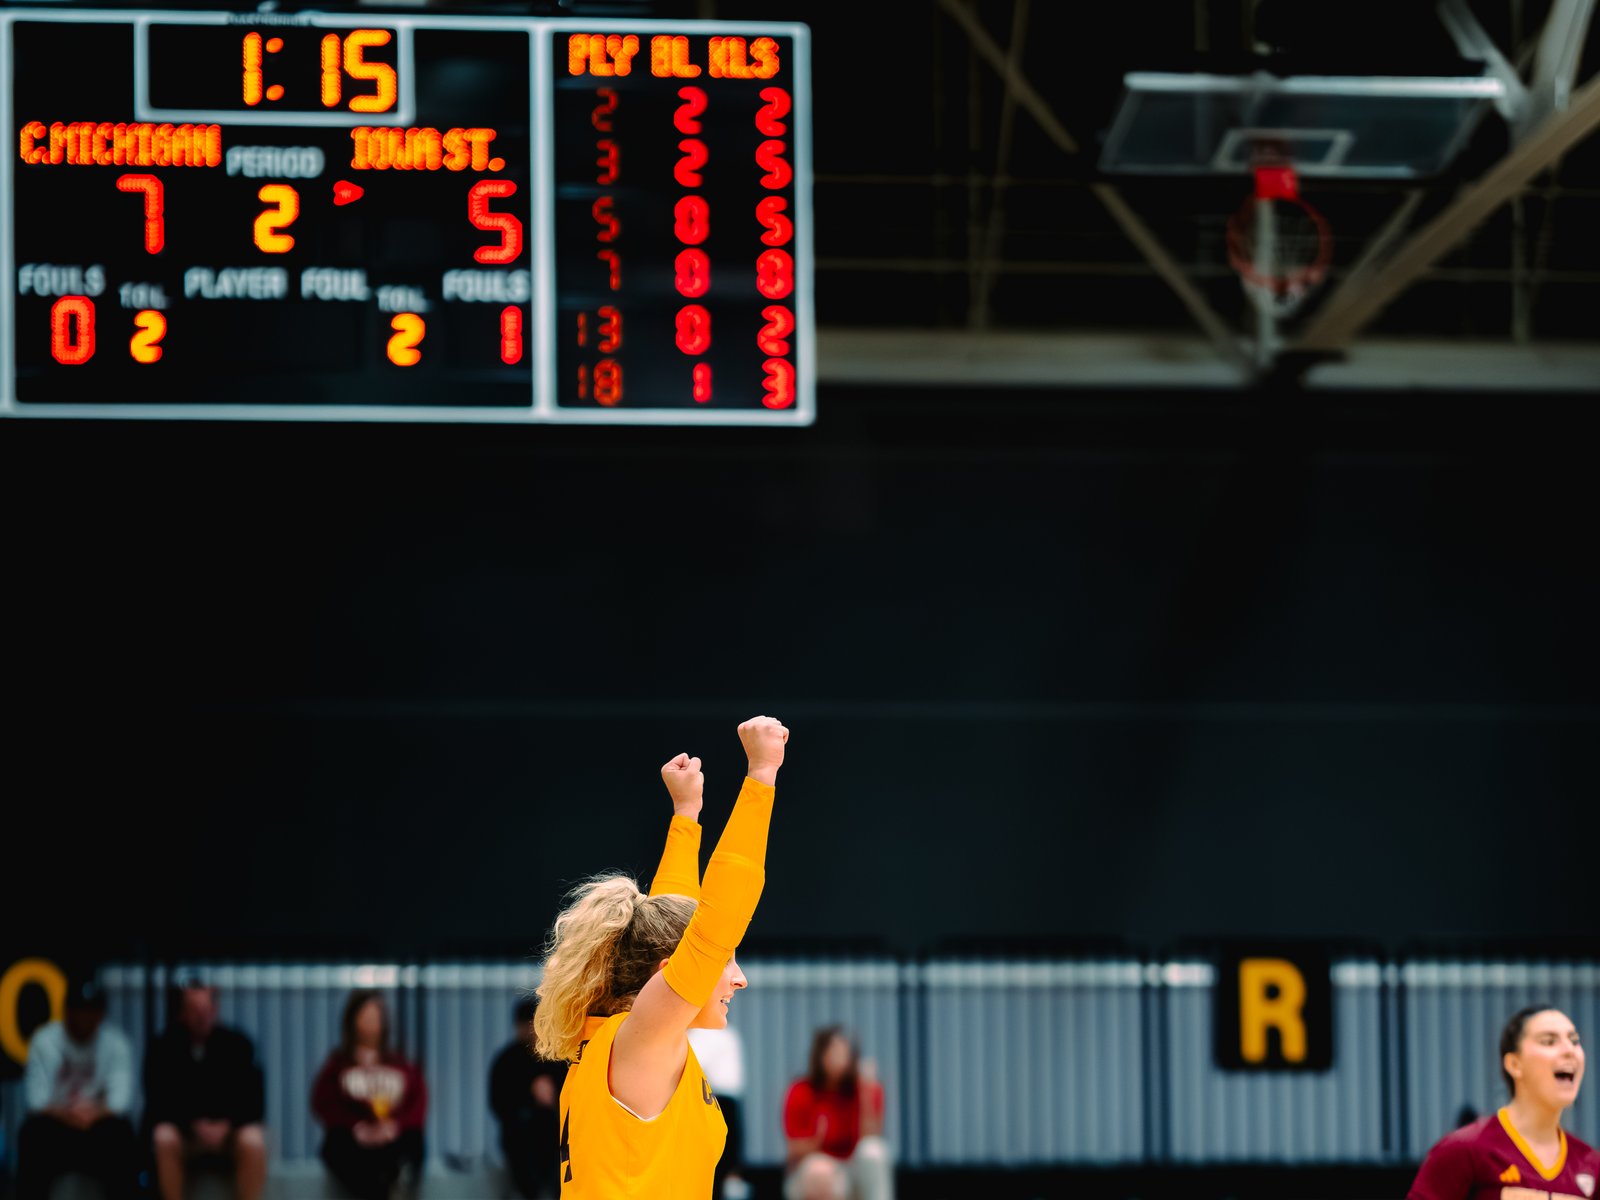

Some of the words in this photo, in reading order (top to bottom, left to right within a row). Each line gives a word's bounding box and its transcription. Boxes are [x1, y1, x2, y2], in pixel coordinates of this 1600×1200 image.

[243, 30, 397, 113] 1:15
[568, 34, 639, 75] PLY
[651, 35, 702, 77] BL
[674, 86, 708, 134] 2
[756, 87, 791, 136] 2
[226, 147, 324, 178] PERIOD
[674, 139, 708, 187] 2
[756, 140, 792, 189] 5
[116, 174, 164, 254] 7
[254, 184, 299, 253] 2
[468, 180, 522, 264] 5
[674, 195, 709, 244] 0
[756, 196, 793, 246] 5
[18, 264, 105, 297] FOULS
[184, 267, 288, 299] PLAYER
[301, 268, 369, 301] FOUL
[442, 269, 530, 303] FOULS
[674, 248, 710, 298] 0
[51, 295, 96, 365] 0
[130, 310, 167, 364] 2
[387, 313, 425, 366] 2
[500, 306, 522, 364] 1
[675, 304, 711, 355] 0
[757, 305, 794, 356] 2
[693, 363, 712, 403] 1
[761, 358, 796, 409] 3
[1239, 958, 1306, 1062] R
